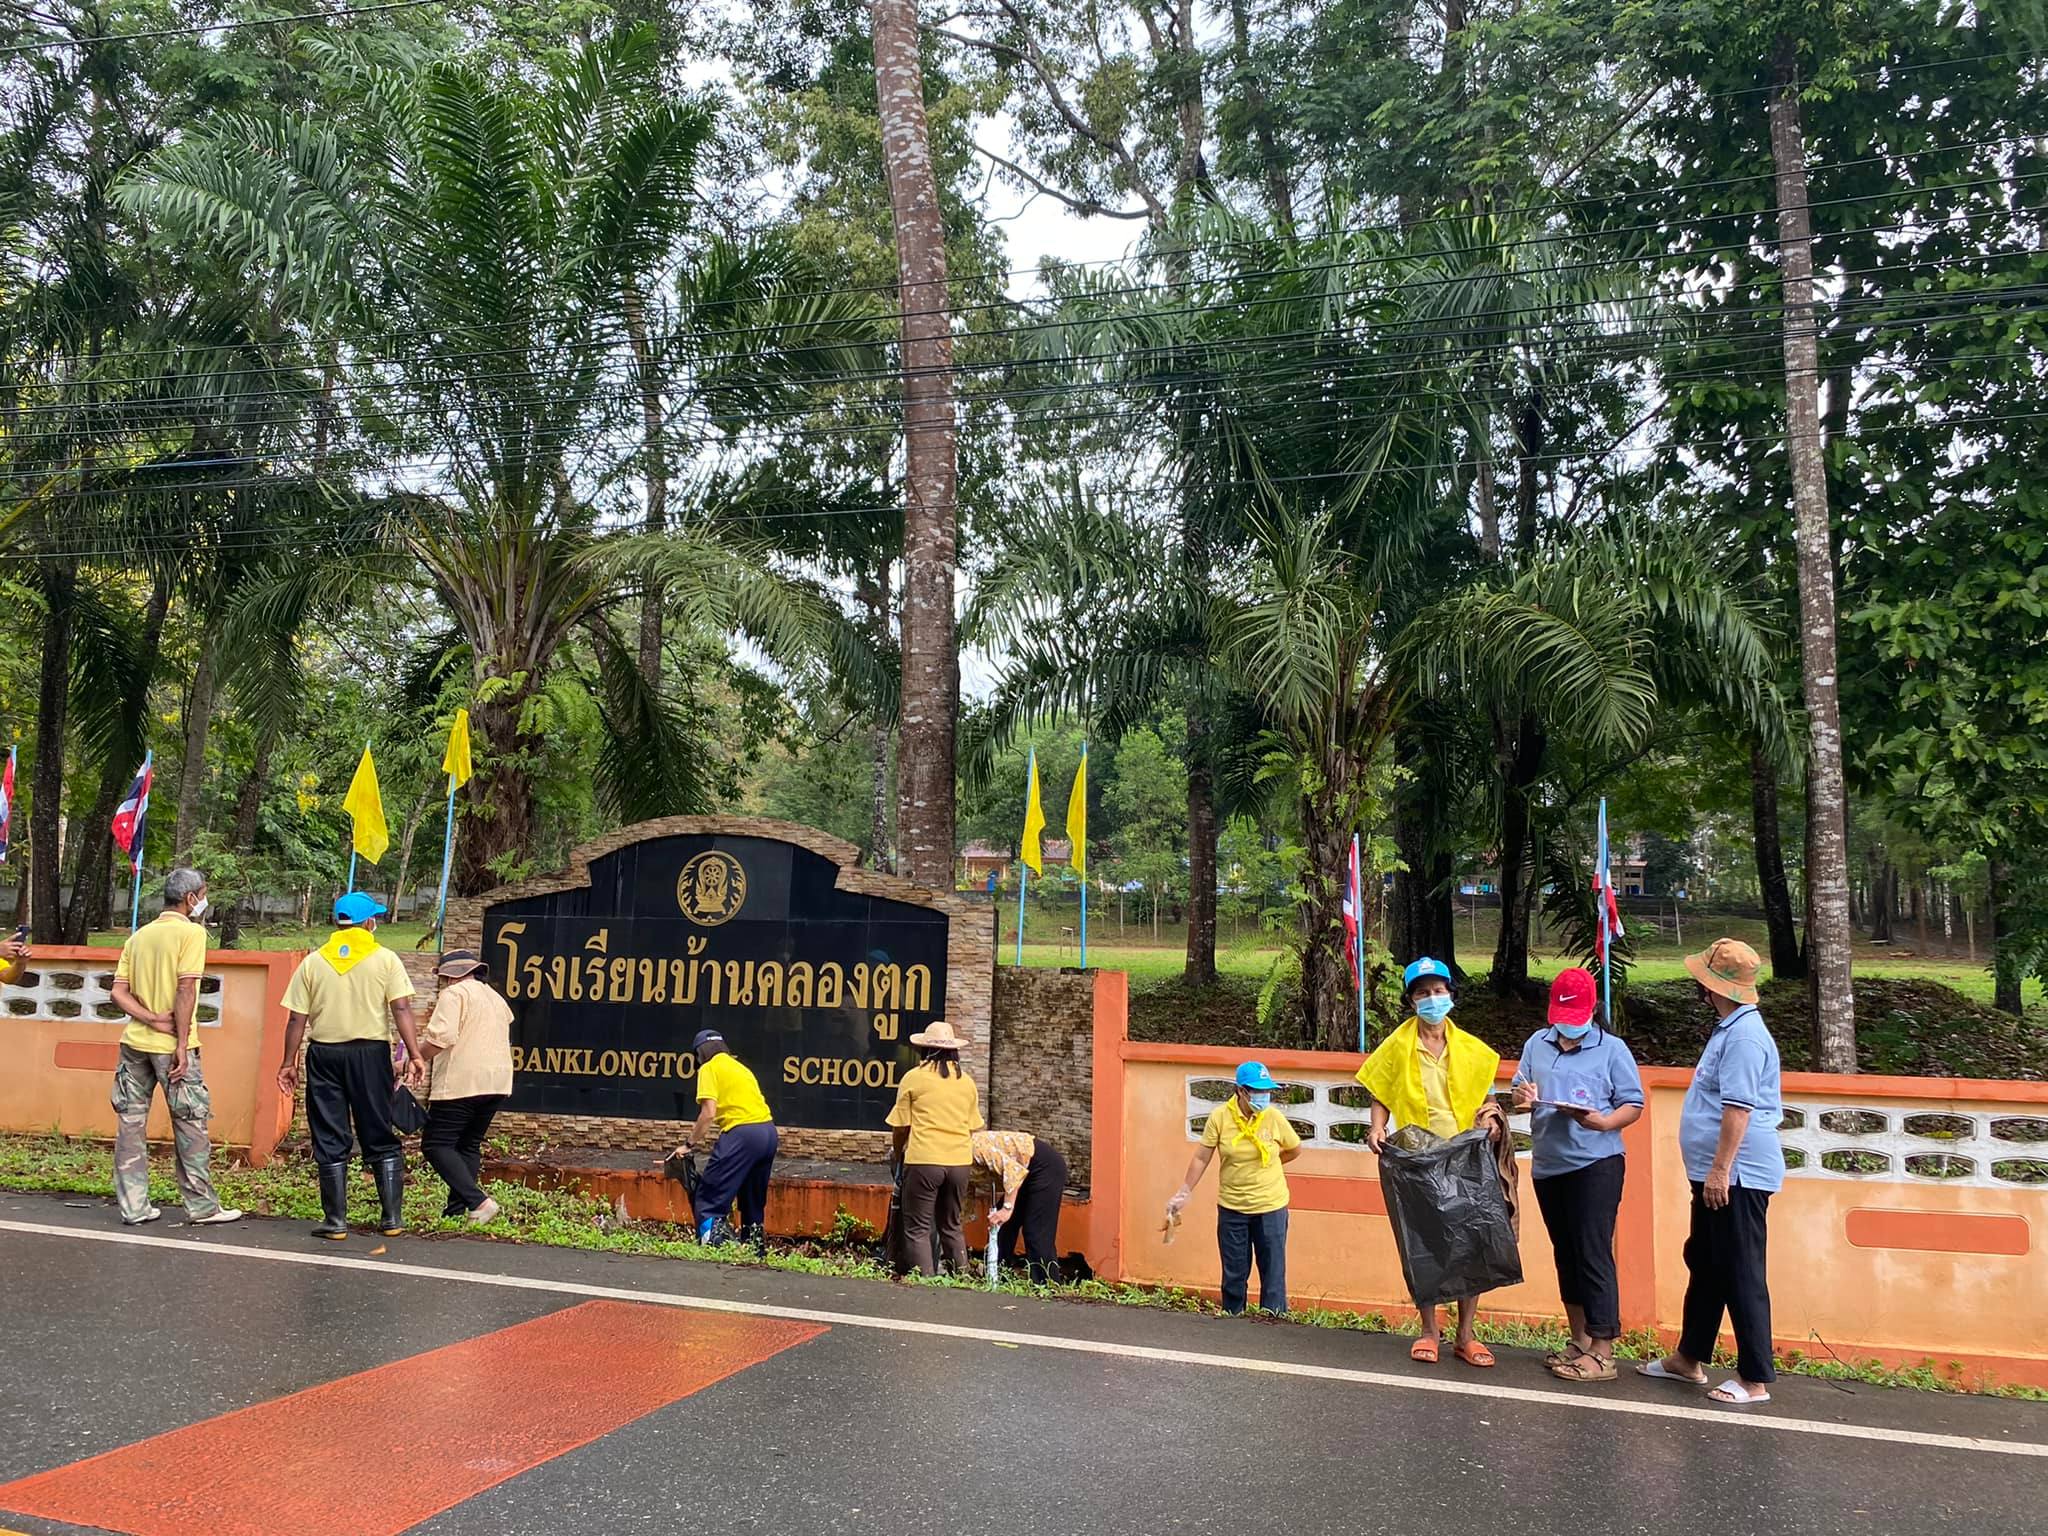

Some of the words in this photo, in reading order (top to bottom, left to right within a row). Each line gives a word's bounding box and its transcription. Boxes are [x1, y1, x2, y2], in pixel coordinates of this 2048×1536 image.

[496, 921, 932, 1041] โรงเรียนบ้านคลองตูก
[783, 1056, 900, 1088] SCHOOL
